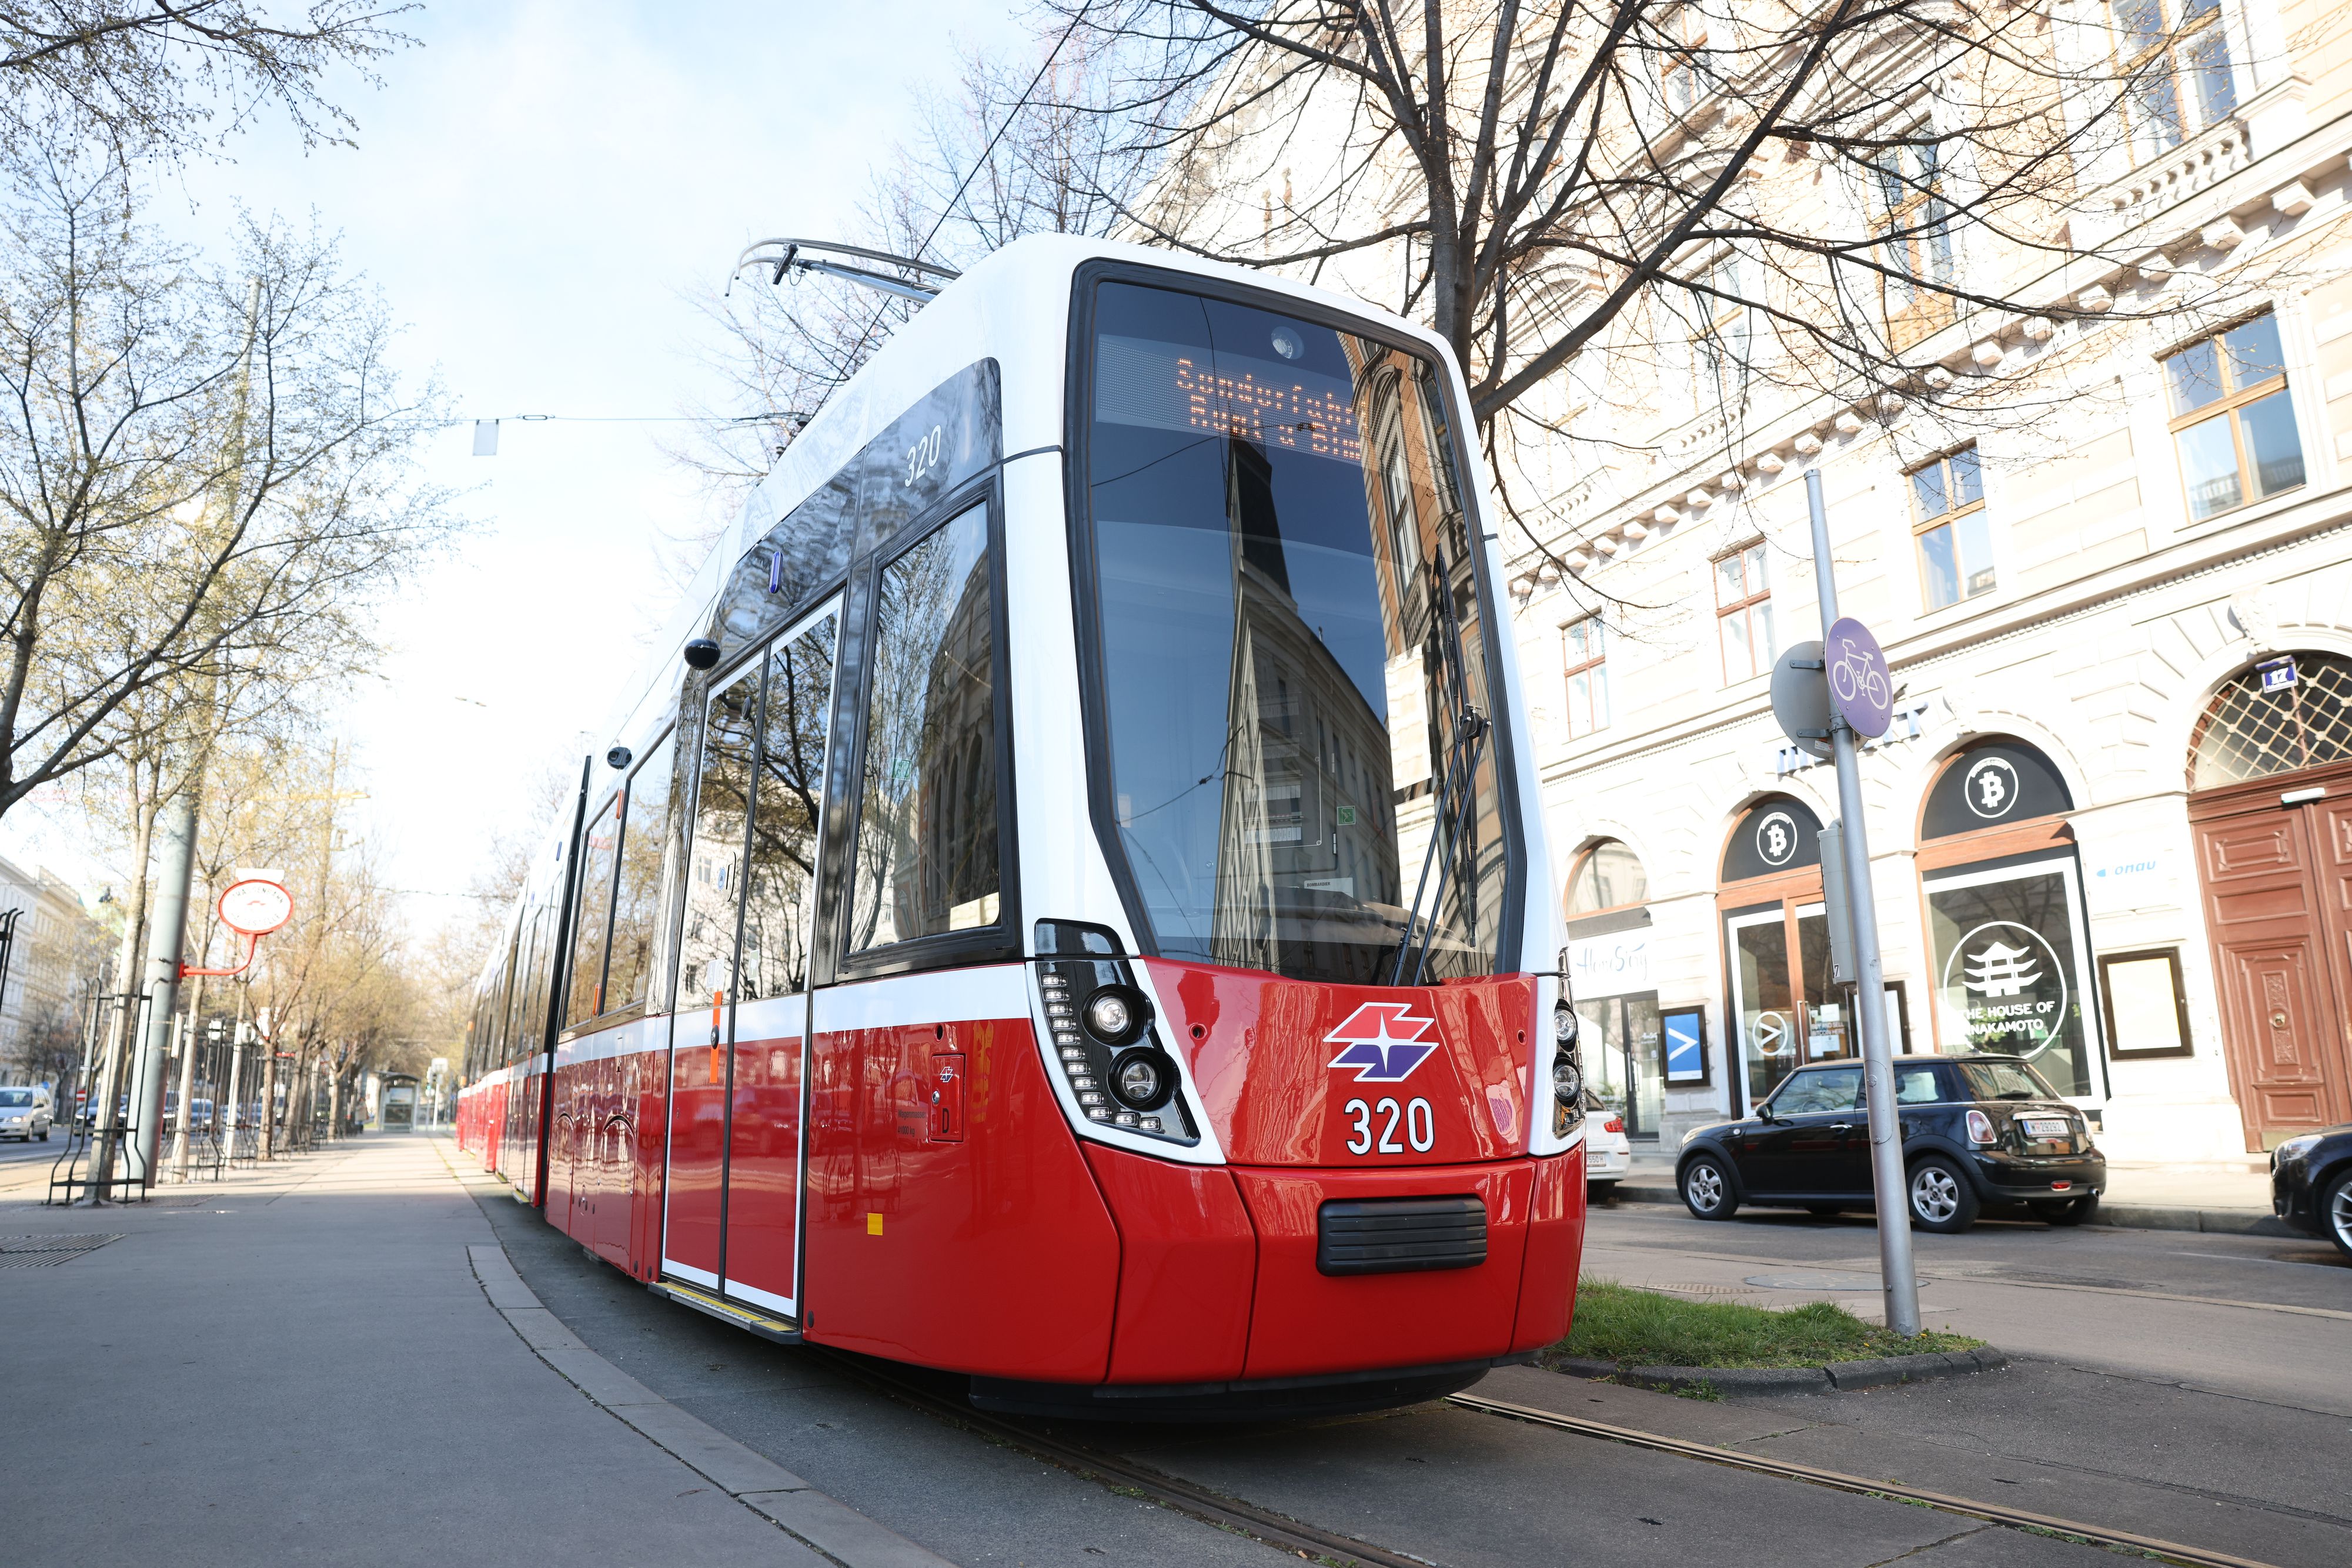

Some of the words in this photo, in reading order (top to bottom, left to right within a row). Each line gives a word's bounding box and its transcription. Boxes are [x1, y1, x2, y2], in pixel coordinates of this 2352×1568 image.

[904, 424, 941, 487] 320
[2270, 667, 2288, 684] 17
[1959, 1008, 1984, 1020] THE
[1987, 1003, 2033, 1017] HOUSE
[2036, 1001, 2055, 1014] OF
[1970, 1018, 2044, 1035] NAKAMOTO
[943, 1108, 950, 1134] D
[1344, 1096, 1435, 1156] 320
[910, 1125, 915, 1137] kg
